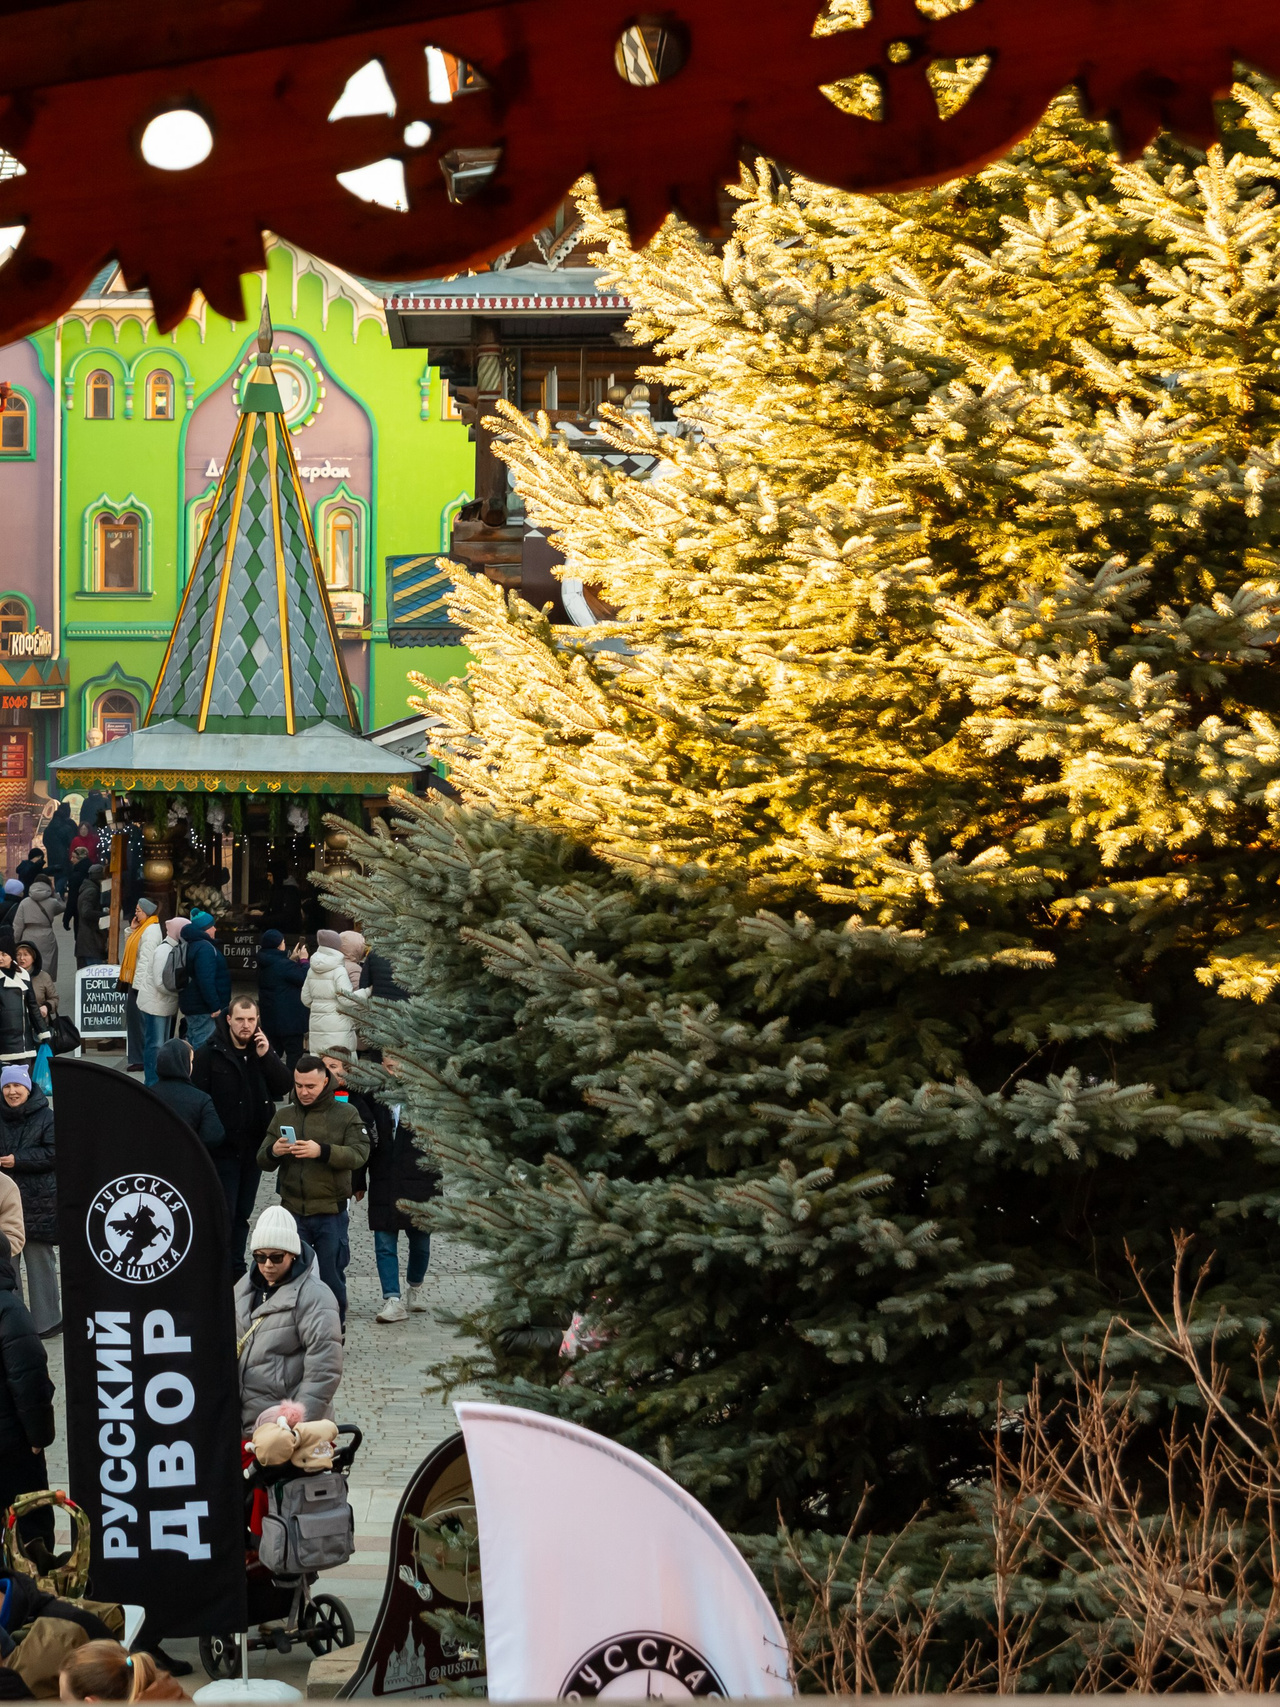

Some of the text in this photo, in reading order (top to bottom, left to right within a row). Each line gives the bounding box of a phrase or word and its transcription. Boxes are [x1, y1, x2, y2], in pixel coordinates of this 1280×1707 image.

[11, 629, 52, 656] КОФЕЙНЯ
[2, 695, 28, 709] КОФЕ
[234, 936, 255, 944] КАФЕ
[85, 980, 110, 990] БОРЩ
[86, 992, 126, 1002] ХАЧАПУРИ
[82, 1004, 125, 1014] ШАШЛЫК
[83, 1016, 122, 1026] ПЕЛЬМЕНИ
[93, 1176, 182, 1214] РУССКАЯ
[99, 1247, 181, 1281] ОБЩИНА
[86, 1310, 139, 1560] РУССКИЙ
[142, 1308, 212, 1561] ДВОР
